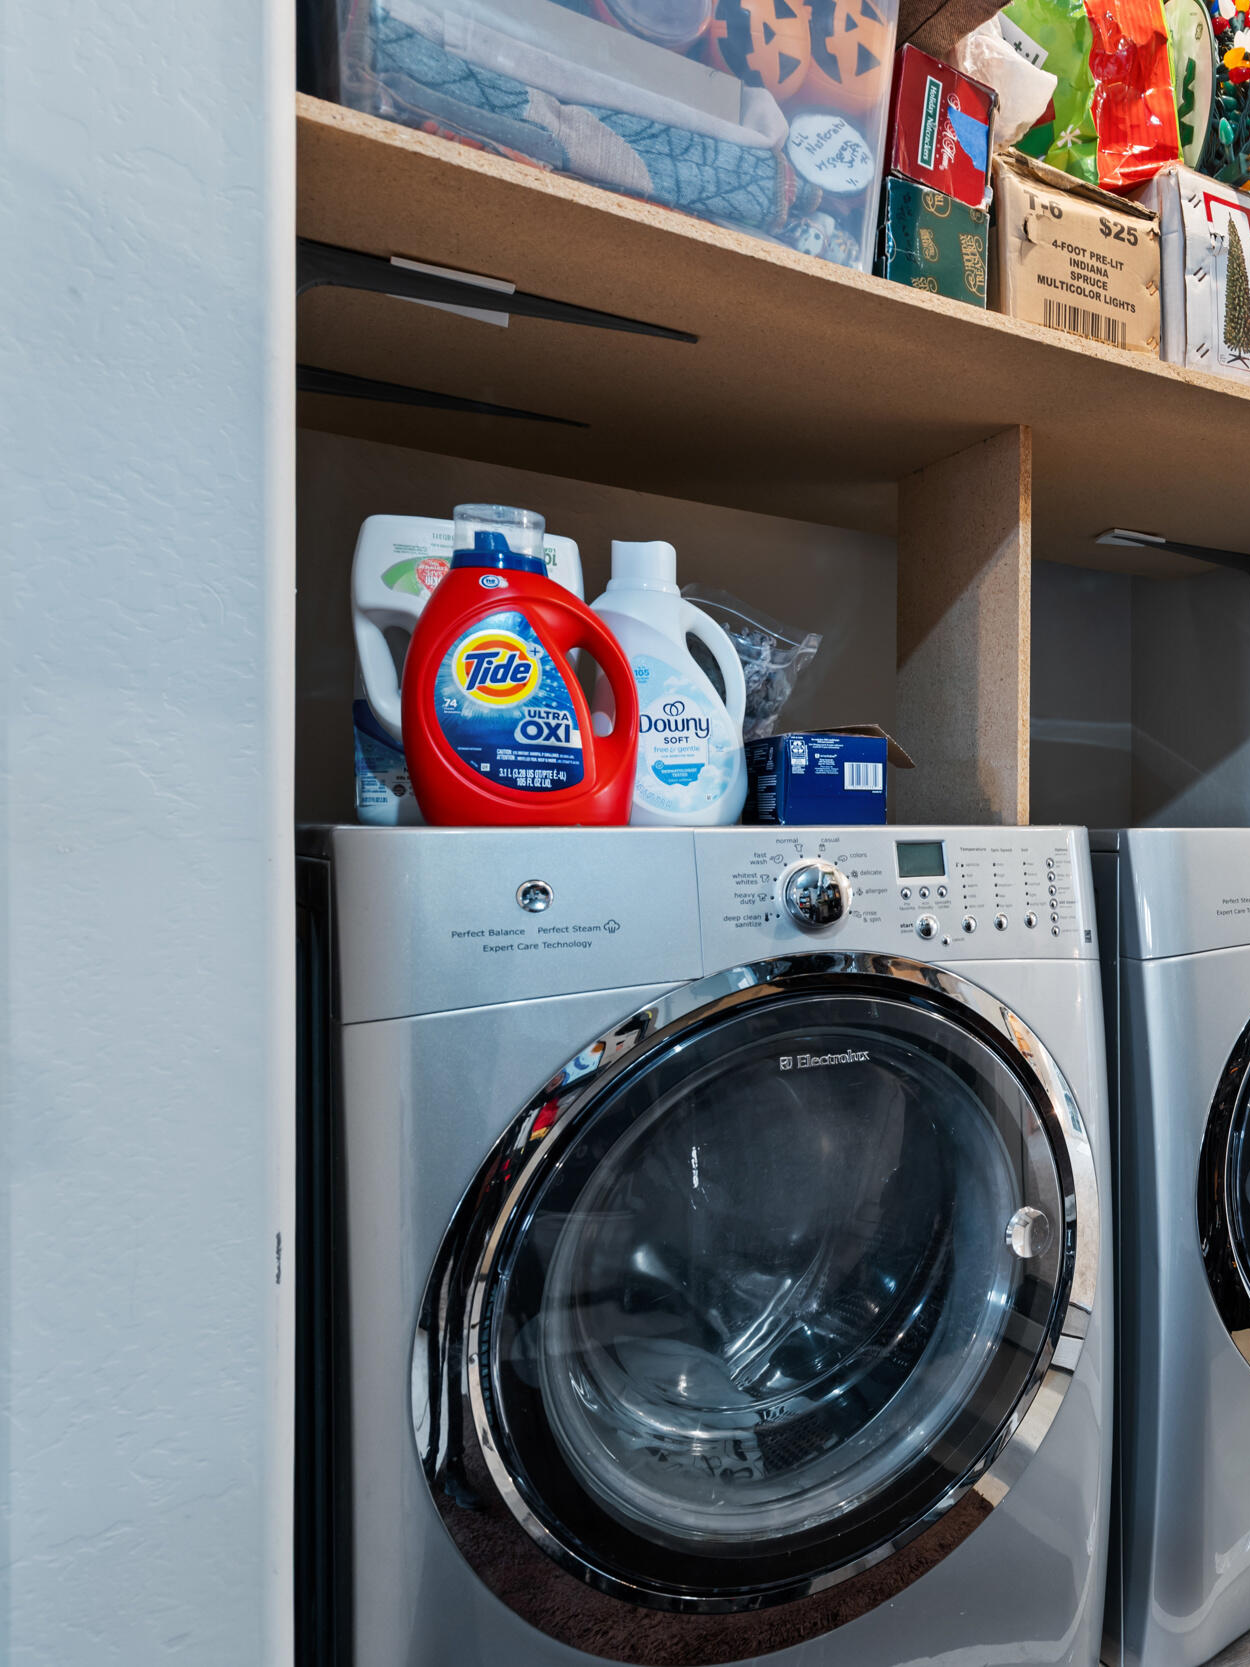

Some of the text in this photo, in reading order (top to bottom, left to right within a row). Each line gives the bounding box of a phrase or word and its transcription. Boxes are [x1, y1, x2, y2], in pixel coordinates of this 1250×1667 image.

[923, 86, 937, 161] Holiday Nutcrackers
[1099, 216, 1139, 246] $25
[1052, 239, 1124, 271] 4-FOOT PRE-LIT
[1069, 257, 1109, 279] INDIANA
[1070, 271, 1108, 291] SPRUCE
[1037, 274, 1136, 313] MULTICOLOR LIGHTS
[464, 651, 532, 691] Tide
[444, 698, 457, 708] 74
[527, 709, 570, 722] ULTRA
[520, 720, 570, 743] OXI
[639, 714, 710, 739] Downy
[663, 736, 690, 745] SOFT
[526, 769, 534, 778] US
[732, 872, 758, 880] whitest
[735, 878, 759, 886] whites
[734, 892, 756, 900] heavy
[451, 924, 601, 939] Perfect Balance Perfect Steam
[735, 920, 762, 928] sanitize
[482, 939, 593, 953] Expert Care Technology
[797, 1049, 870, 1069] Electrolux
